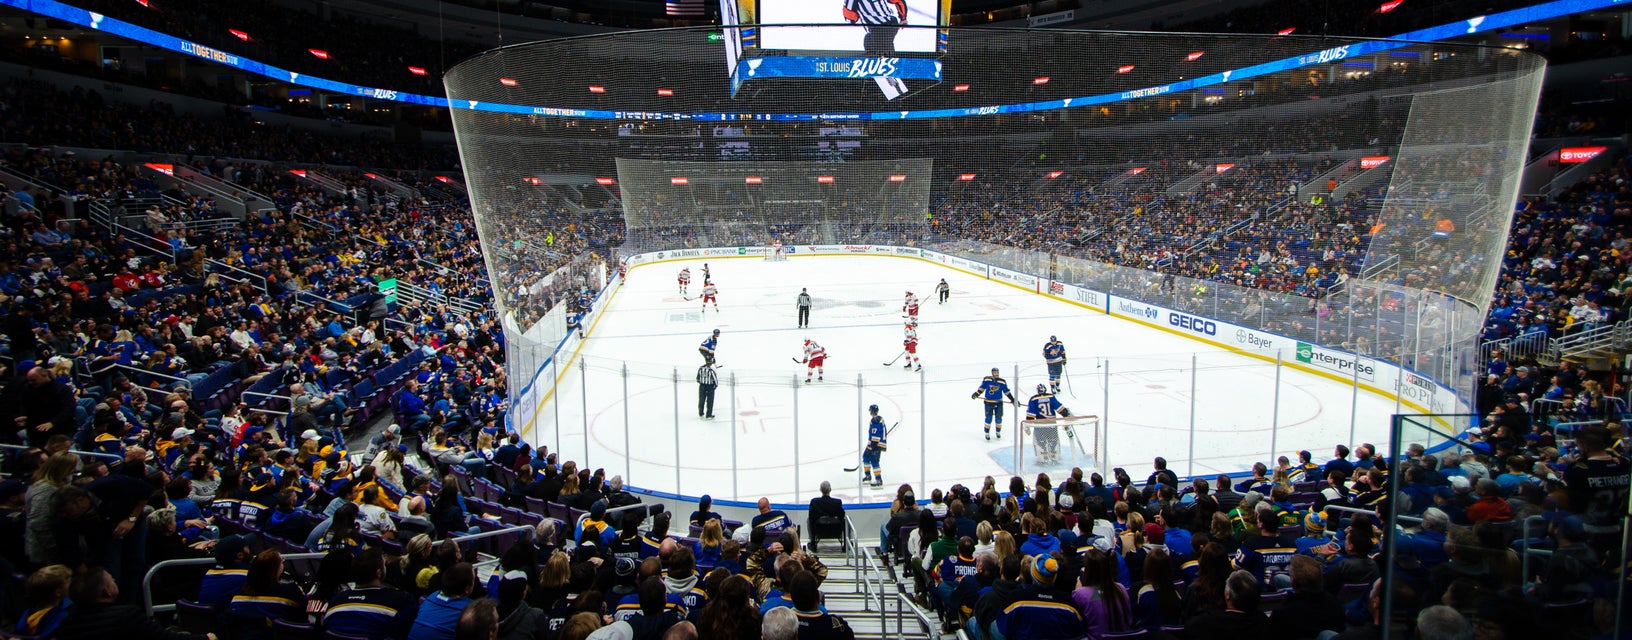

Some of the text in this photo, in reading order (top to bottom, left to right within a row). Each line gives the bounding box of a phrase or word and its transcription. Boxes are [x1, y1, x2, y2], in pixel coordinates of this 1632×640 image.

[1317, 45, 1349, 63] BLUES
[819, 62, 829, 72] ST.
[830, 62, 850, 72] LOUIS
[848, 57, 899, 77] BLUES
[374, 88, 397, 100] BLUES
[1118, 301, 1144, 316] Anthem
[1169, 313, 1216, 336] GEICO
[1248, 333, 1272, 349] Bayer
[1300, 349, 1374, 375] enterprise
[1394, 378, 1417, 398] PRO
[1037, 402, 1054, 417] 31
[1587, 475, 1630, 487] PIETRANG
[1235, 549, 1245, 562] 91
[955, 565, 978, 576] PRONG
